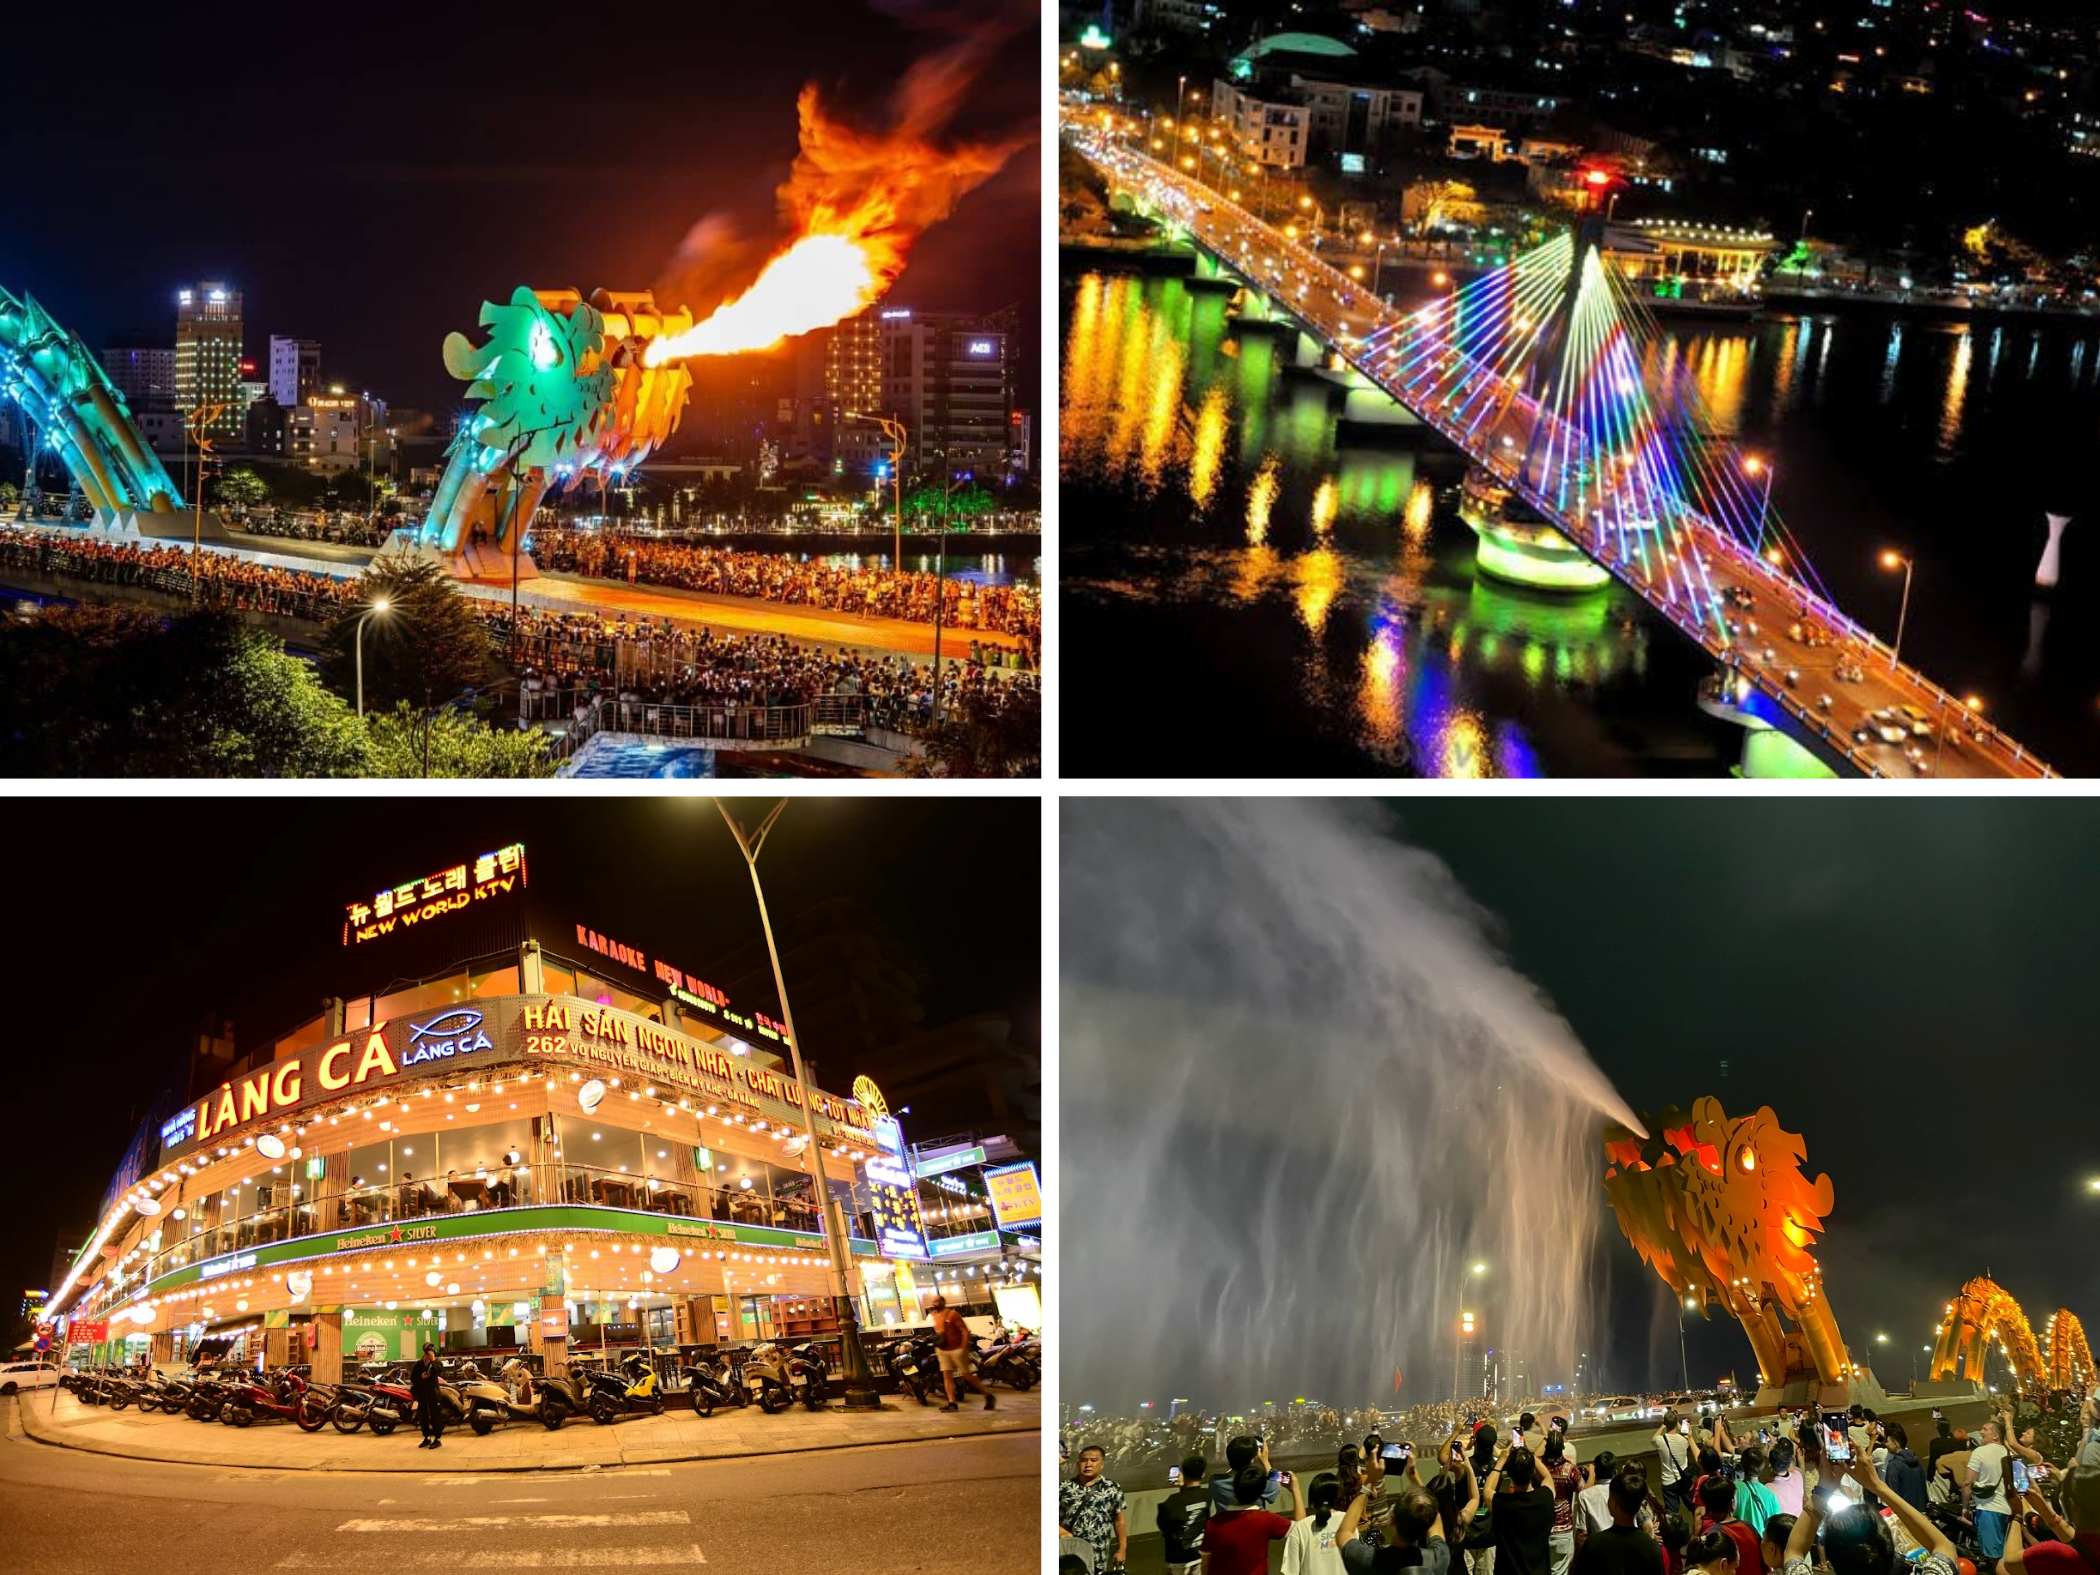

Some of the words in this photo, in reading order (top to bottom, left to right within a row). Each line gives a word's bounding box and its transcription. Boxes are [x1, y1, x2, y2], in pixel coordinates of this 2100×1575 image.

[421, 865, 466, 899] 노래
[473, 845, 520, 883] 클럽
[356, 917, 397, 943] NEW
[401, 893, 470, 926] WORLD
[474, 875, 515, 900] KTV
[576, 924, 646, 972] KARAOKE
[654, 959, 683, 988] NEW
[402, 1041, 455, 1066] LÀNG
[458, 1030, 493, 1053] CÁ
[524, 997, 571, 1030] HẢI
[583, 1007, 629, 1043] SẢN
[636, 1025, 689, 1063] NGON
[526, 1036, 567, 1054] 262
[197, 1059, 301, 1141] LÀNG
[318, 1020, 398, 1090] CÁ
[337, 1234, 386, 1250] Heineken
[407, 1226, 437, 1240] SILVER
[667, 1222, 707, 1237] Heineken
[344, 1315, 398, 1326] Heineken
[416, 1316, 439, 1326] SILVER
